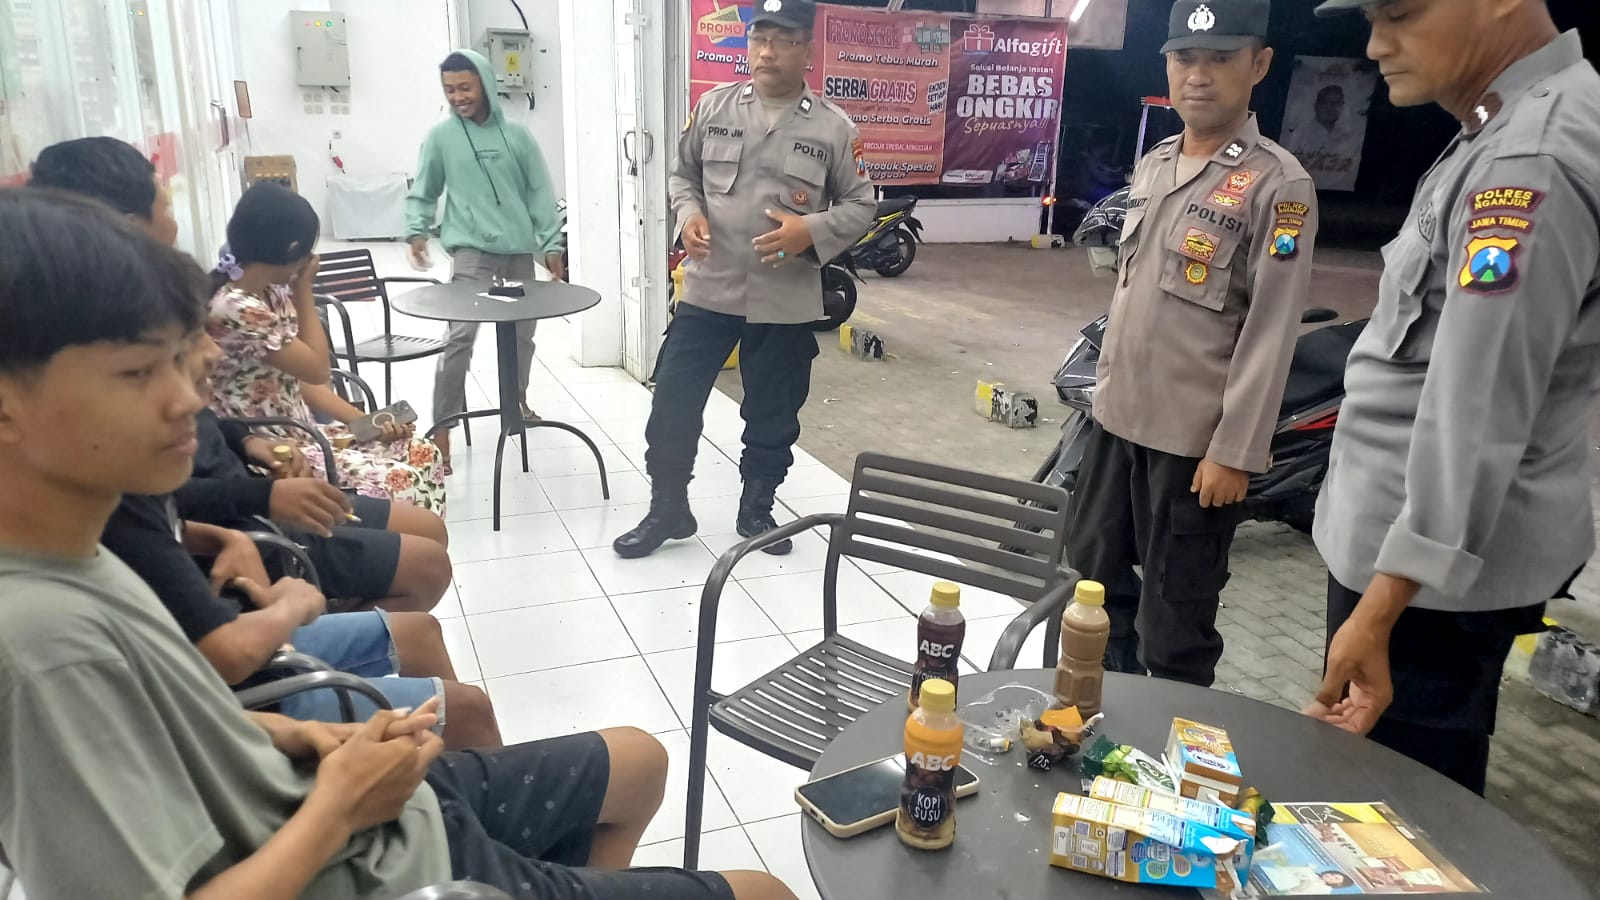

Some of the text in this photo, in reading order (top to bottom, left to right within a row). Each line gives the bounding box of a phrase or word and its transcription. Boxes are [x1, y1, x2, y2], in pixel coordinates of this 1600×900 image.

[700, 22, 741, 34] PROMO
[993, 37, 1063, 57] Alfagift
[697, 50, 733, 63] Promo
[838, 50, 939, 68] Promo Tebus Murah
[825, 76, 917, 103] SERBA GRATIS
[967, 74, 1053, 97] BEBAS
[957, 96, 1059, 119] ONGKIR
[848, 113, 931, 125] omo Serba Gratis
[708, 126, 728, 136] PRIO
[793, 142, 828, 162] POLRI
[865, 161, 936, 173] Produk Spesial
[1474, 197, 1531, 210] NGANJUK
[1475, 189, 1534, 202] POLRES
[1187, 204, 1242, 233] POLISI
[1470, 217, 1530, 229] JAWA TIMUR
[920, 639, 954, 658] ABC
[911, 752, 955, 771] ABC
[917, 792, 940, 810] KOPI
[914, 806, 940, 822] SUSU
